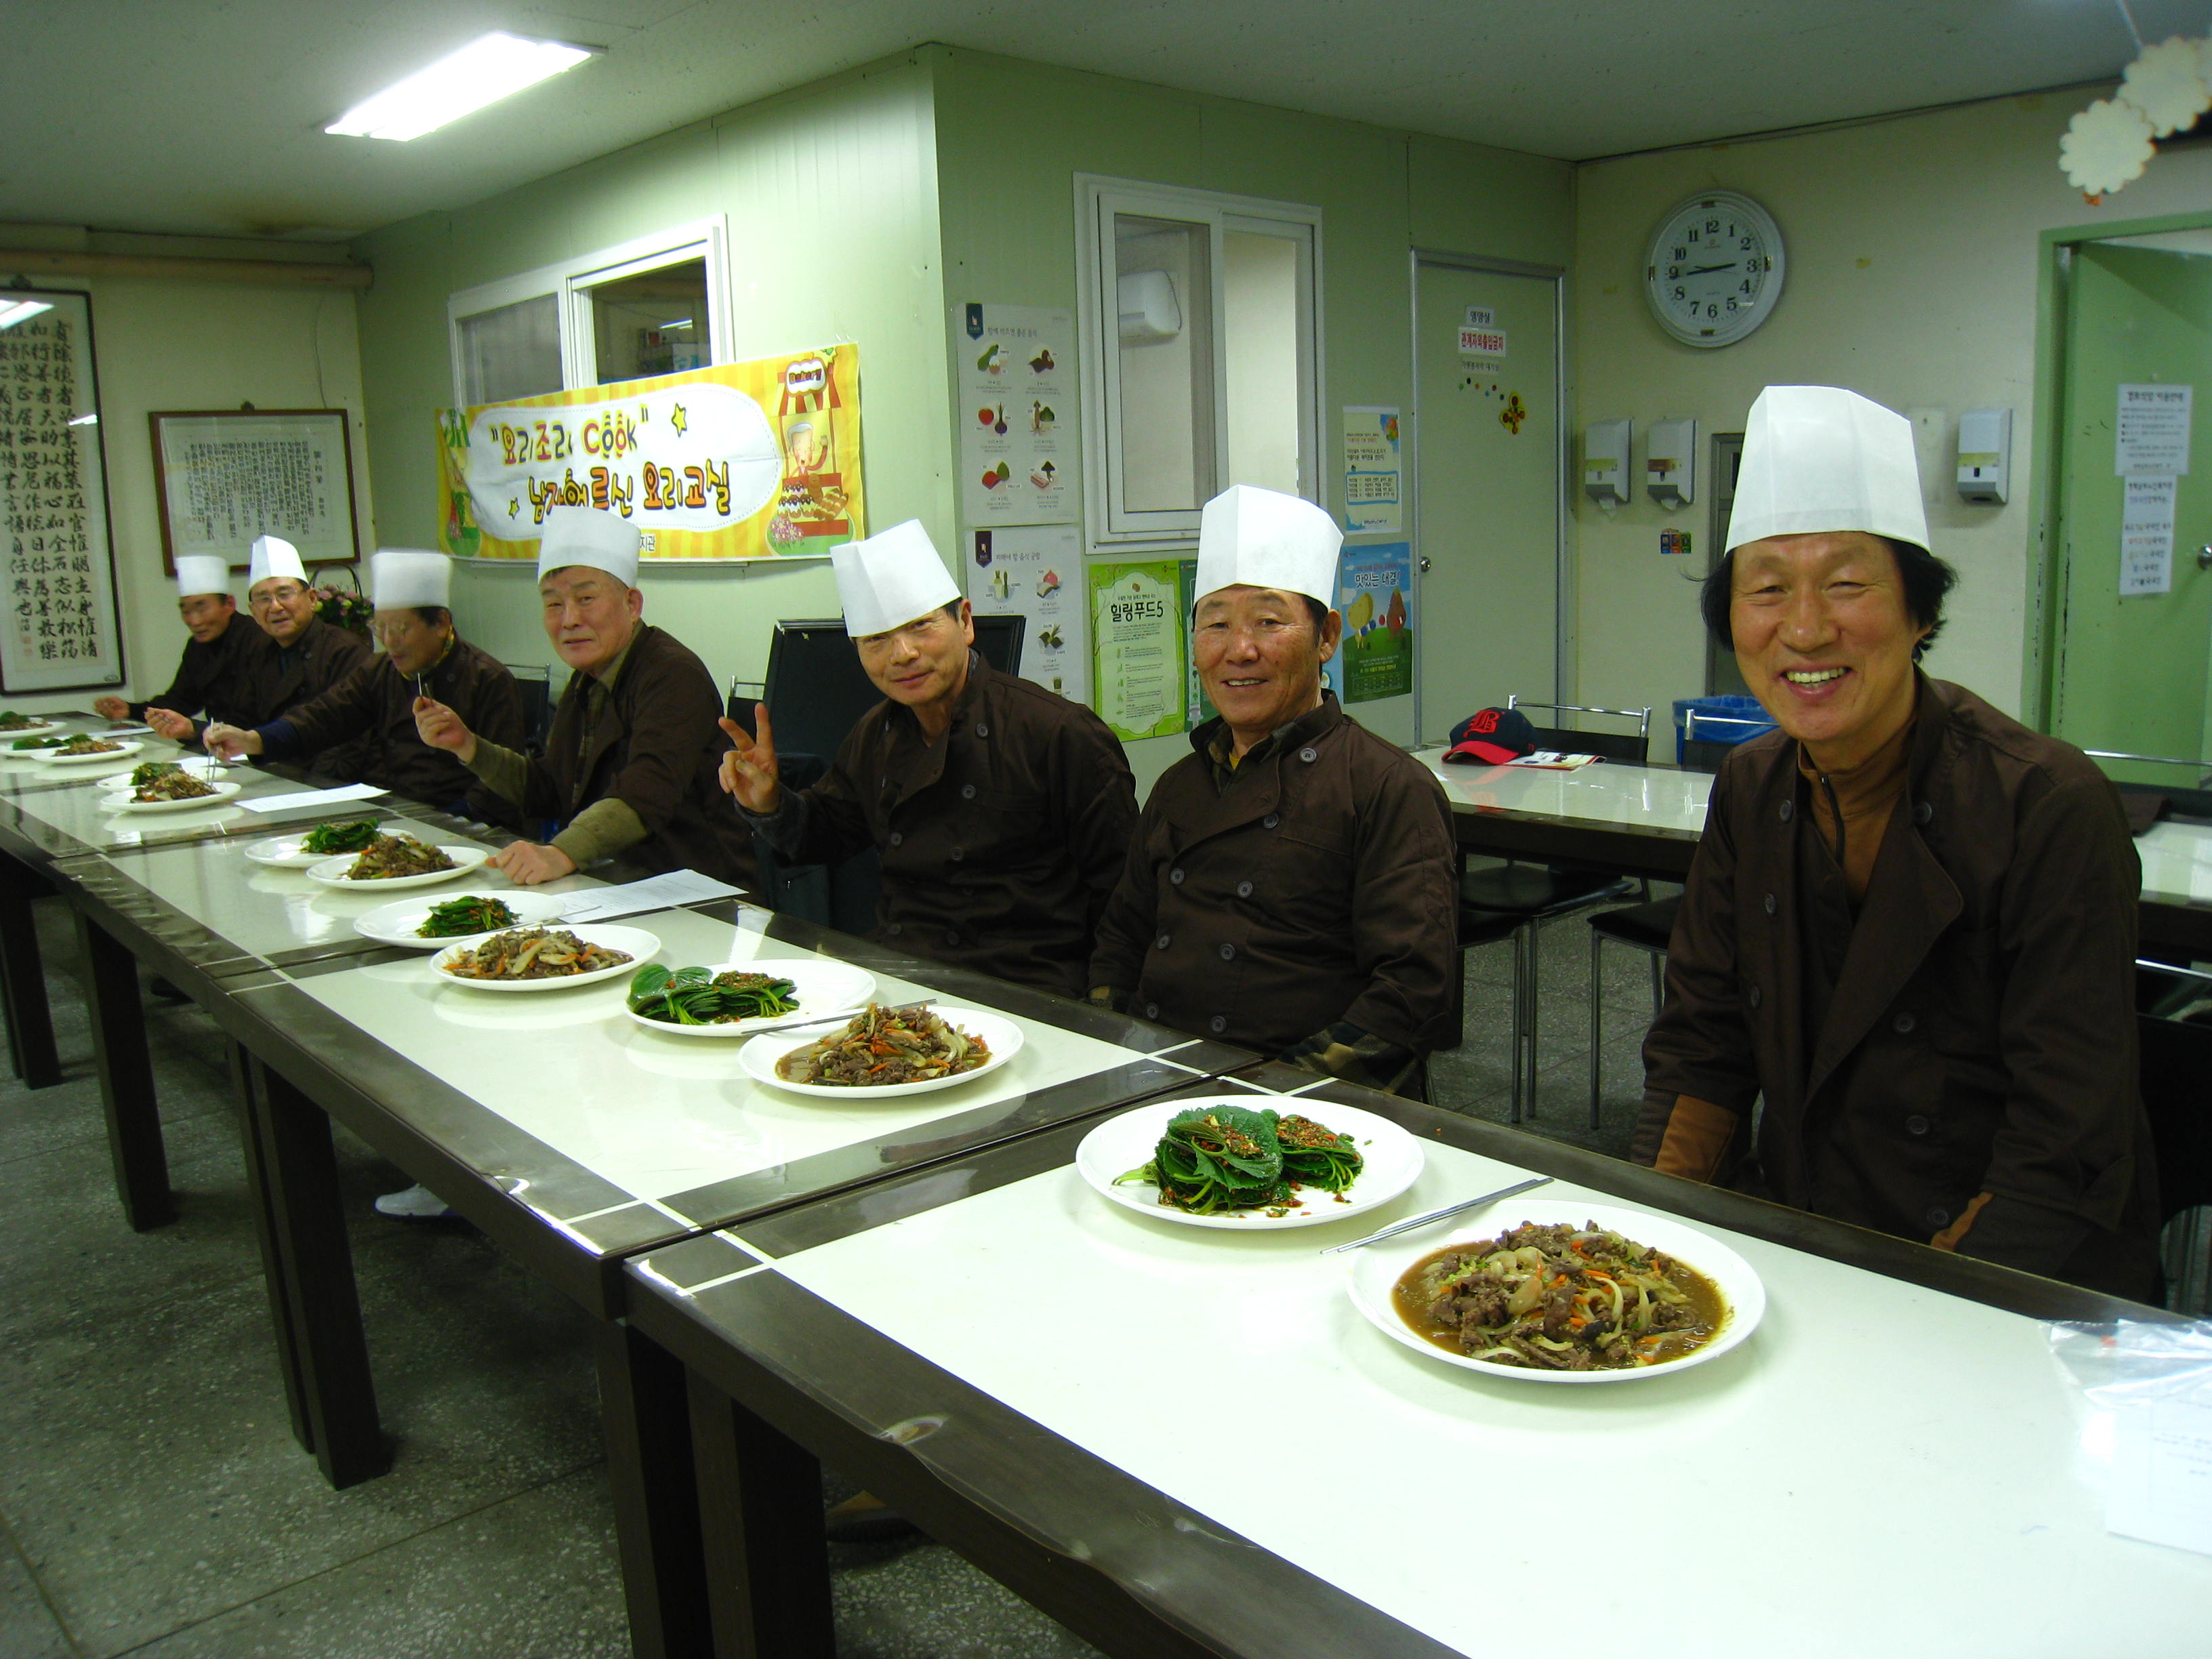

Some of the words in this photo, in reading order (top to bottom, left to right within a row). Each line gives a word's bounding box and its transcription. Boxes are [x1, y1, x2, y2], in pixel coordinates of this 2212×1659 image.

[1705, 220, 1719, 234] 12
[1727, 224, 1735, 237] 1
[1687, 228, 1698, 243] 11
[1740, 237, 1751, 251] 2
[1674, 247, 1687, 261] 10
[1668, 266, 1679, 279] 9
[1746, 259, 1757, 272] 3
[1674, 286, 1685, 300] 8
[1739, 279, 1750, 293] 4
[1689, 301, 1700, 315] 7
[1726, 297, 1736, 311] 5
[1469, 310, 1490, 324] 영양실
[1707, 304, 1718, 319] 6
[788, 368, 823, 385] Bakery
[528, 467, 634, 525] 남자어르신
[643, 458, 731, 516] 요리교실
[1355, 572, 1380, 588] 맛있는
[1382, 570, 1401, 586] 대결!
[1110, 600, 1164, 623] 힐링푸드5
